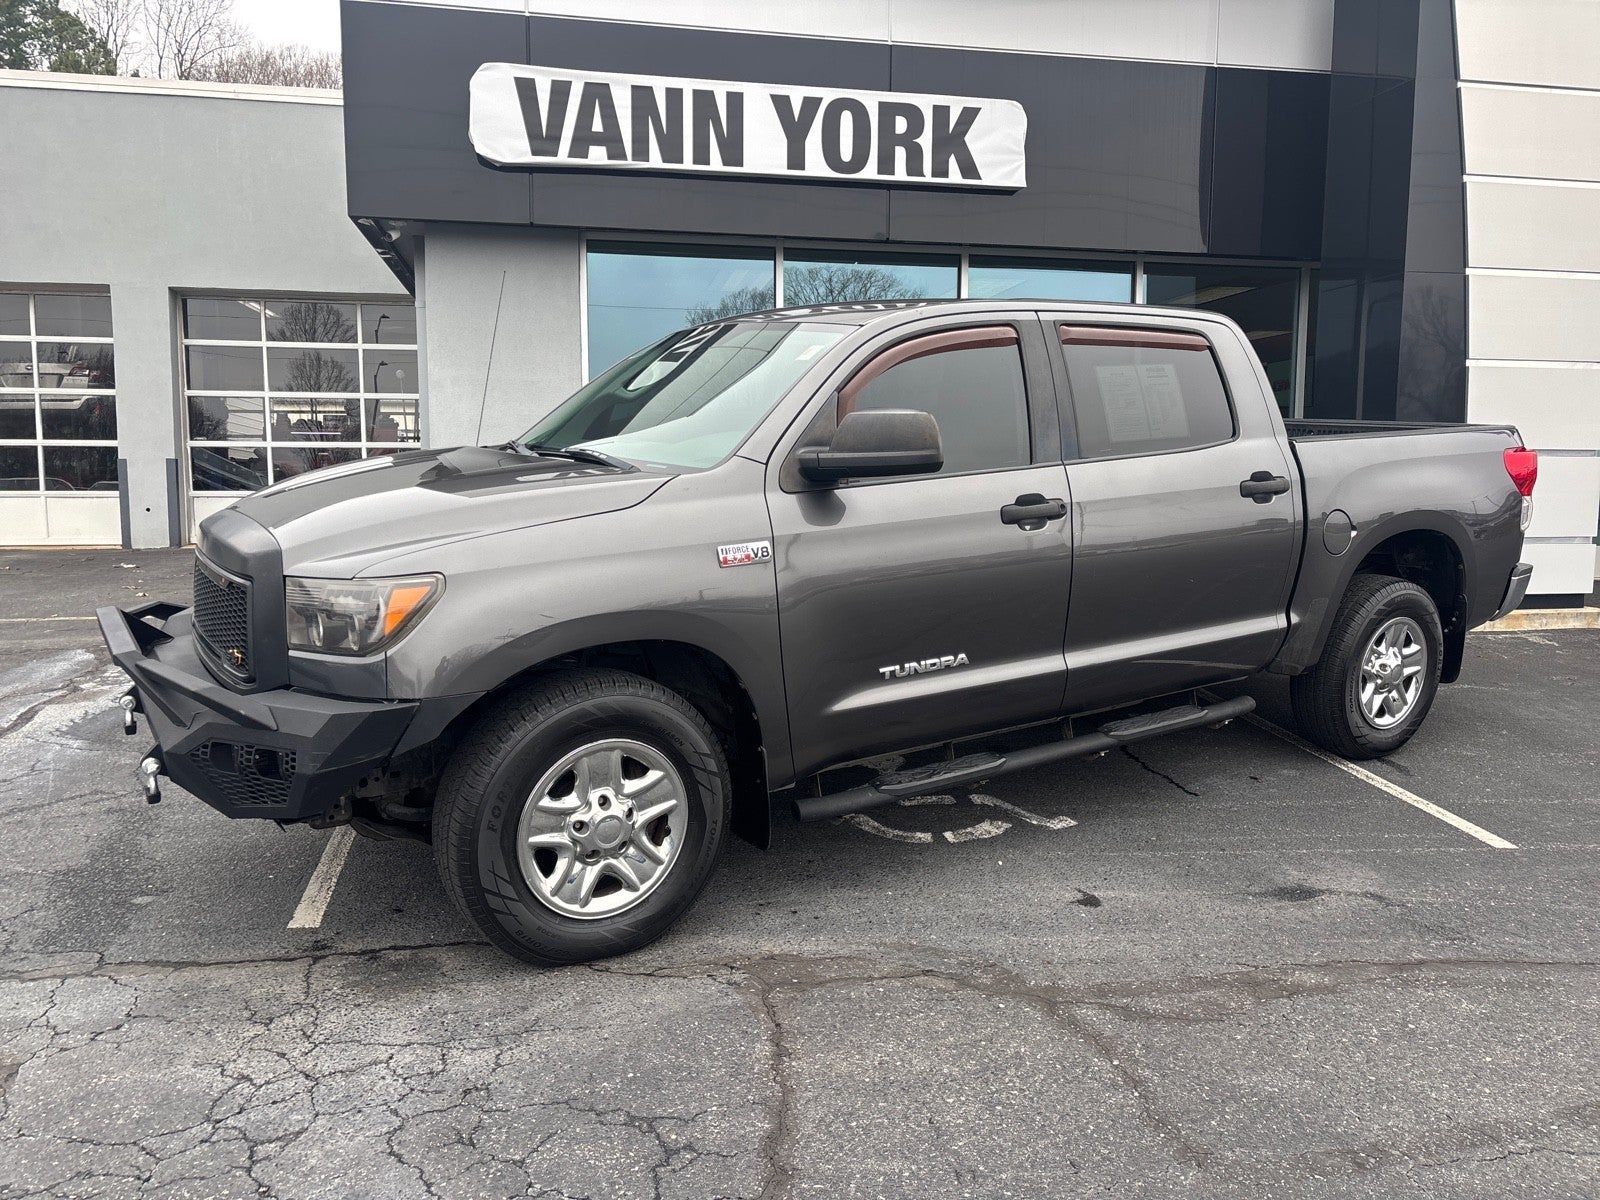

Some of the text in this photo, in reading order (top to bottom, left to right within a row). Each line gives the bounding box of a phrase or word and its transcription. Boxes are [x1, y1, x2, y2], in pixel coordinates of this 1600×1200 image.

[513, 76, 982, 180] VANN YORK
[751, 546, 770, 558] V8
[879, 653, 970, 680] TUNDRA
